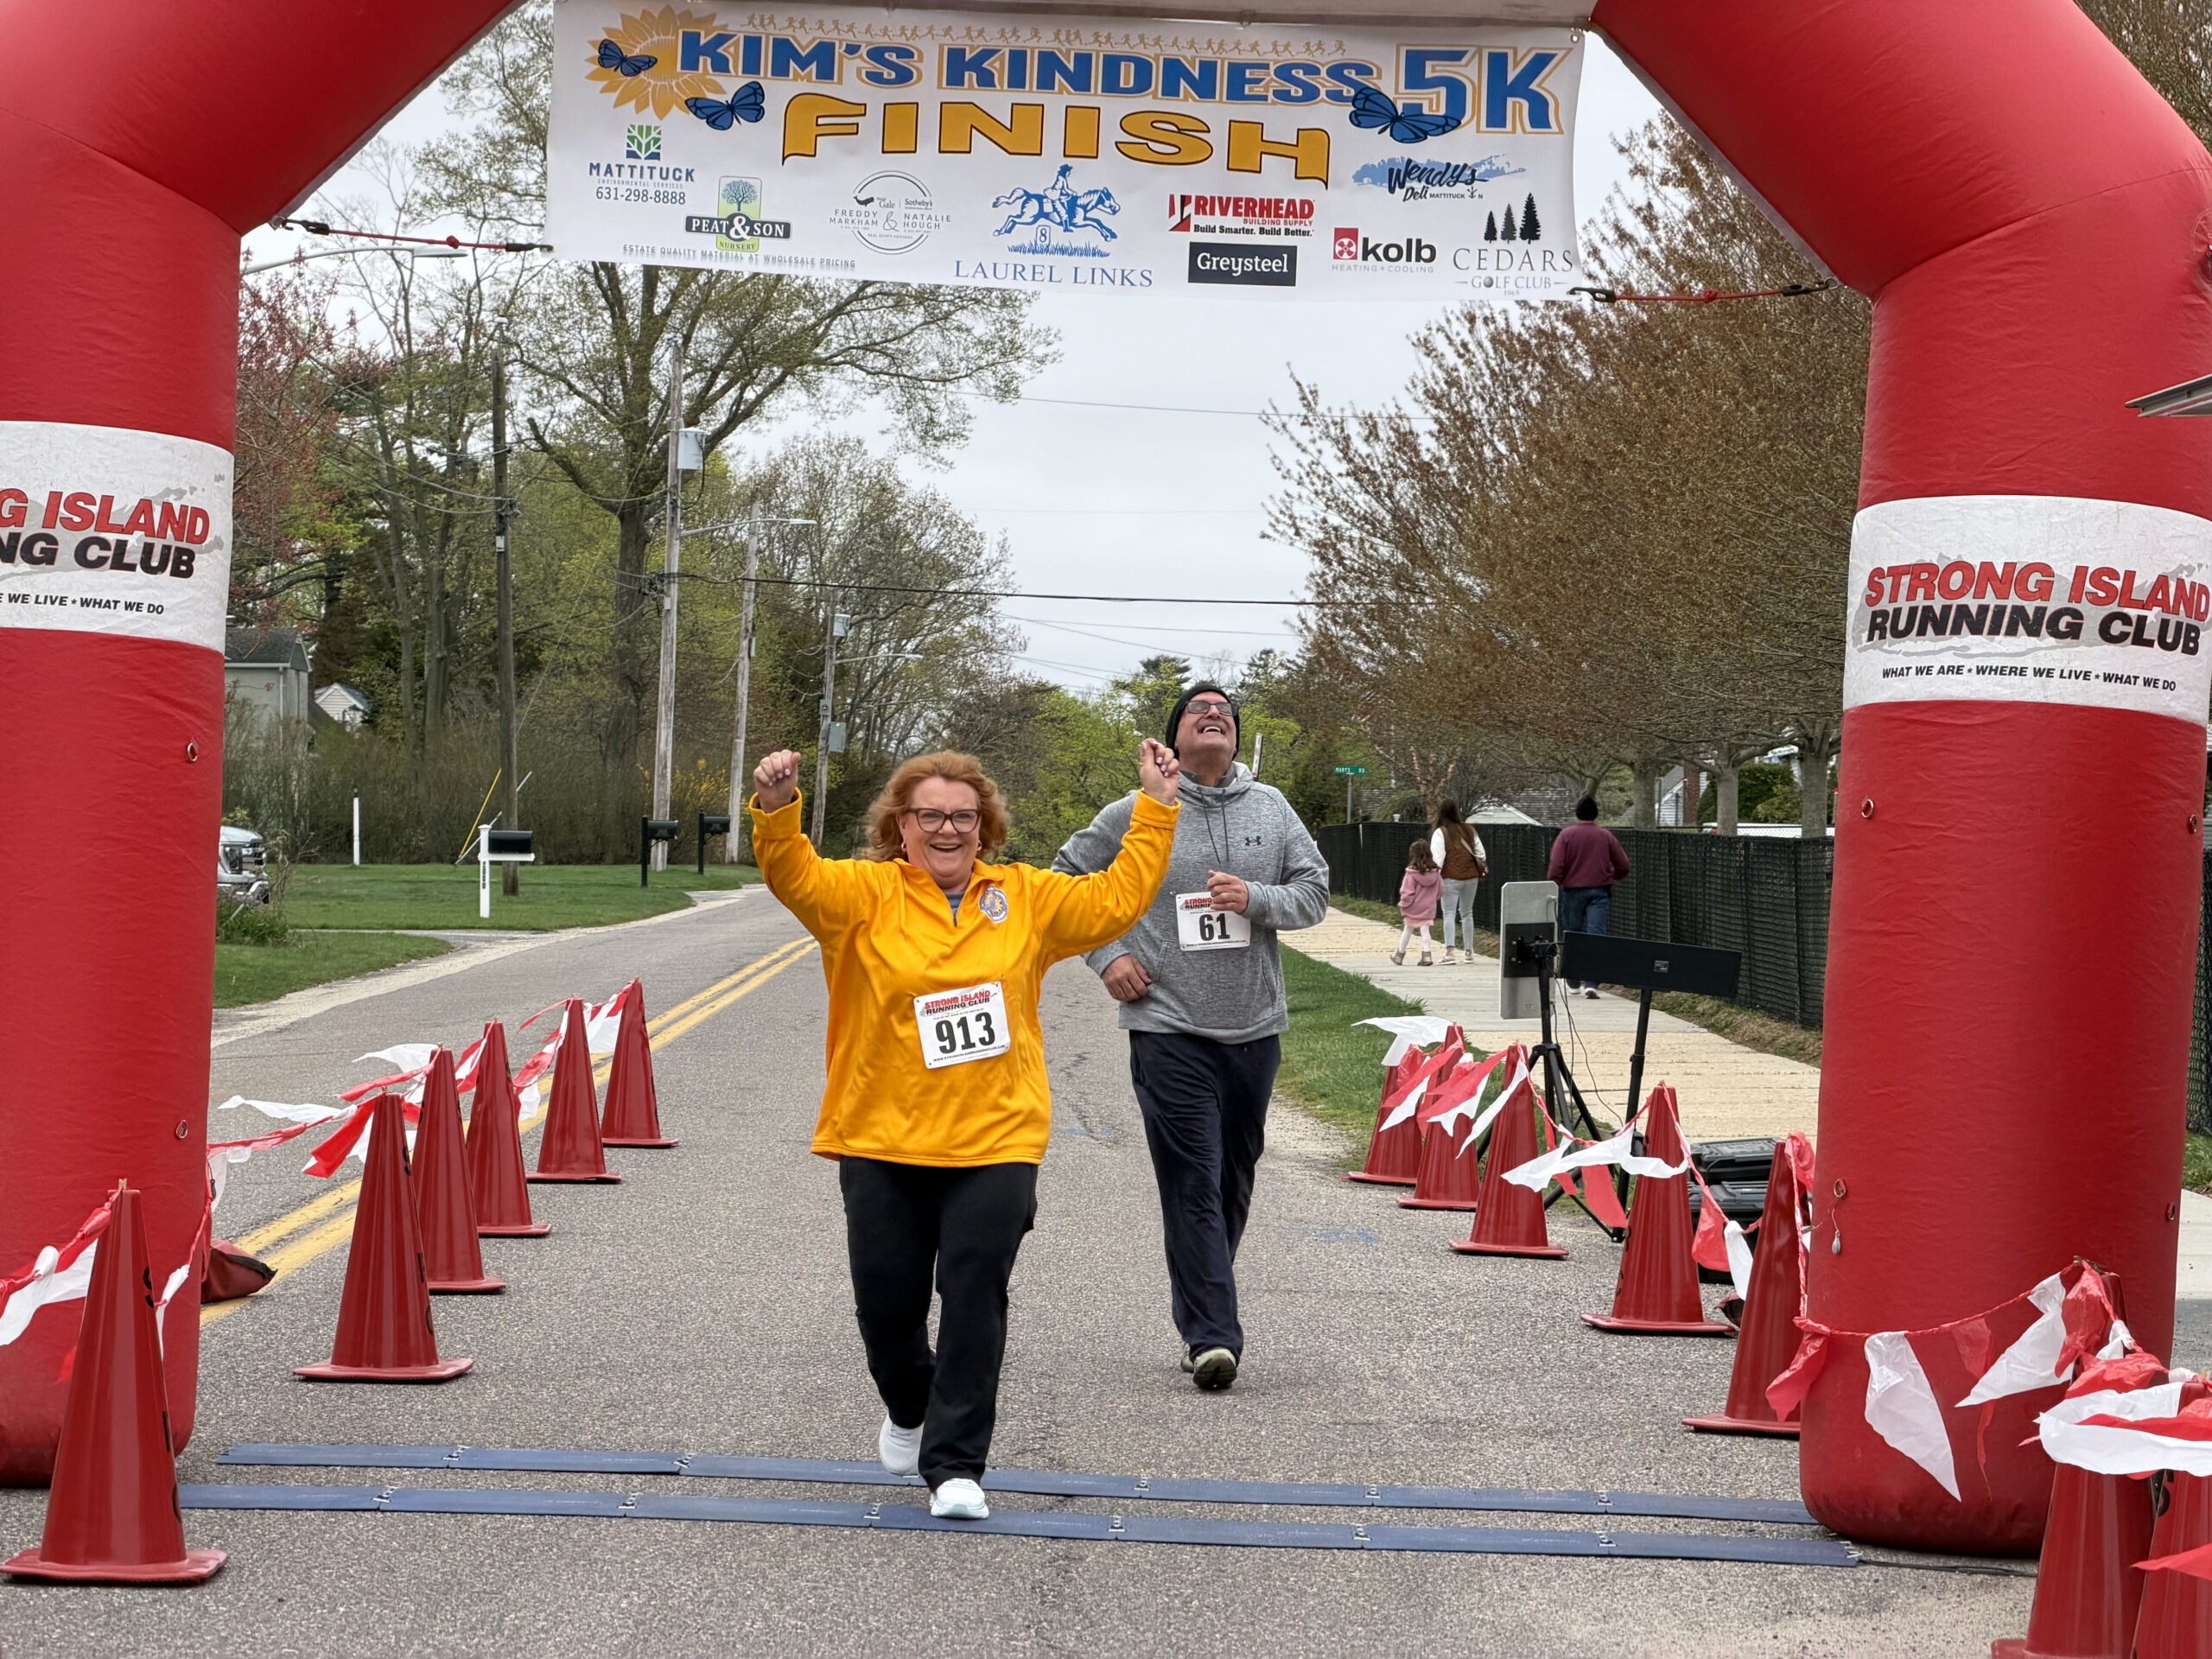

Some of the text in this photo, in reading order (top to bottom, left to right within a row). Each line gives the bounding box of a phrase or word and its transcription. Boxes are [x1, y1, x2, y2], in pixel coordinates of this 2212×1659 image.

[677, 29, 1573, 135] KIM'S KINDNESS 5K
[782, 92, 1330, 190] FINISH
[588, 162, 696, 182] MATTITUCK
[1388, 159, 1489, 194] Wendy's
[595, 187, 686, 205] 631-298-8888
[879, 198, 933, 208] Gale Sotheby's
[1402, 185, 1428, 202] Deli
[835, 208, 878, 218] FREDDY
[904, 213, 951, 222] NATALIE
[1194, 195, 1314, 219] RIVERHEAD
[691, 215, 785, 239] PEAT & SON
[830, 217, 878, 226] MARKHAM
[903, 221, 940, 230] HOUGH
[1193, 224, 1313, 237] Build Smarter. Build Better.
[719, 241, 756, 251] NURSERY
[1039, 228, 1048, 243] 8
[623, 244, 855, 268] ESTATE QUALITY MATERIAL AT WHOLESALE PRICING
[1361, 237, 1437, 263] kolb
[1452, 248, 1573, 272] CEDARS
[954, 260, 1153, 287] LAUREL LINKS
[1197, 252, 1288, 276] Greysteel
[1332, 264, 1377, 272] HEATING
[1514, 276, 1552, 289] CLUB
[41, 491, 210, 545] ISLAND
[73, 536, 196, 579] CLUB
[1865, 560, 2210, 622] STRONG ISLAND
[8, 593, 30, 604] WE
[34, 594, 68, 606] LIVE
[79, 597, 120, 610] WHAT
[124, 601, 143, 612] WE
[147, 603, 164, 614] DO
[1866, 603, 2201, 656] RUNNING CLUB
[1882, 664, 2177, 691] WHAT WE ARE WHERE WE LIVE WHAT WE DO
[1199, 912, 1230, 941] 61
[925, 990, 991, 1010] STRONG ISLAND
[926, 1001, 966, 1015] RUNNING
[968, 997, 990, 1007] CLUB
[935, 1012, 995, 1054] 913
